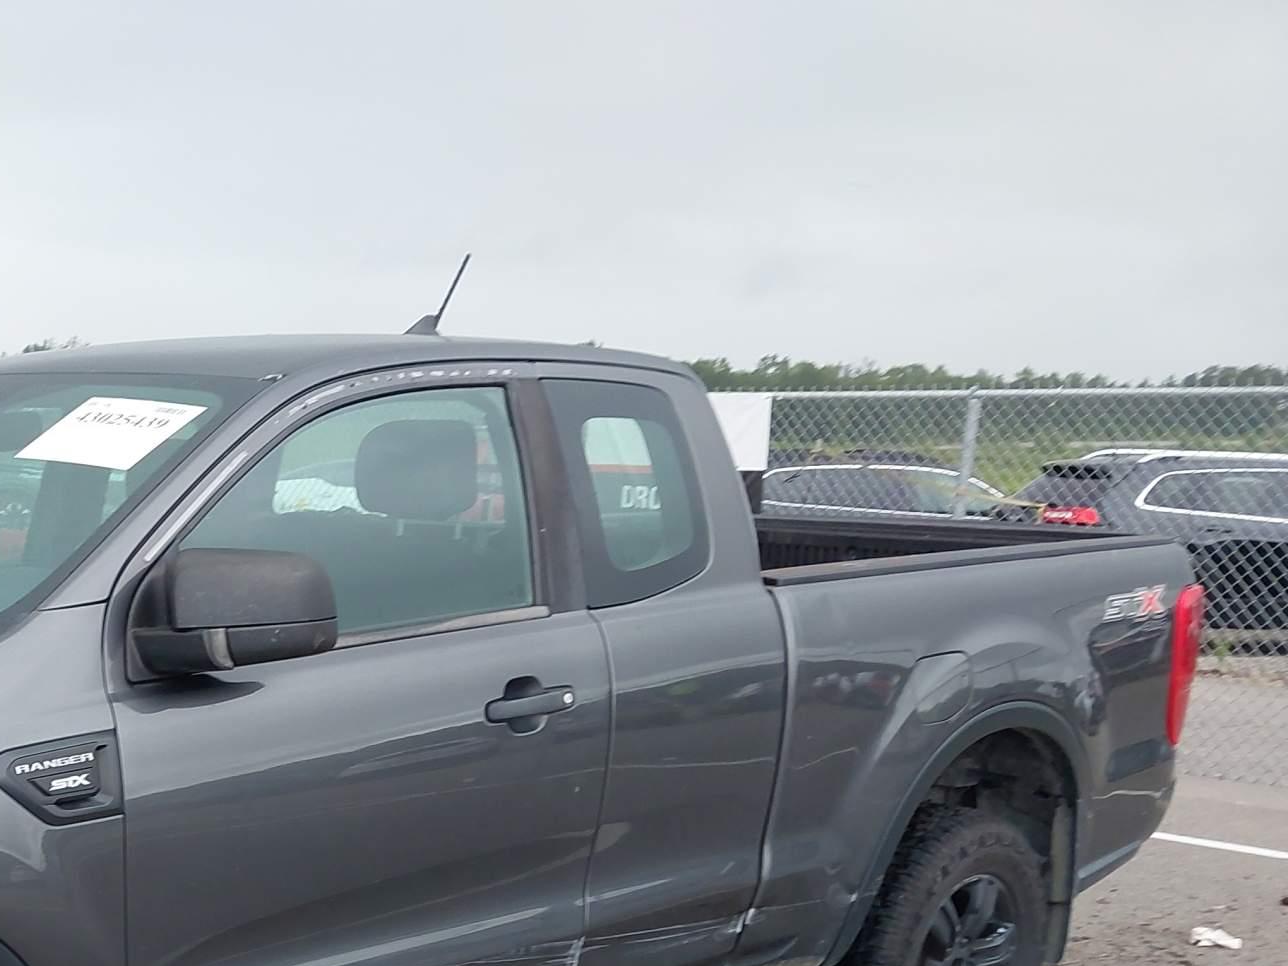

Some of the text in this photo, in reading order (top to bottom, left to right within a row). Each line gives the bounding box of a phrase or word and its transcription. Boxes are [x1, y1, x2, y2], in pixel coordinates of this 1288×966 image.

[75, 411, 172, 429] 43025439
[14, 752, 94, 775] RANGER
[48, 773, 91, 791] STX
